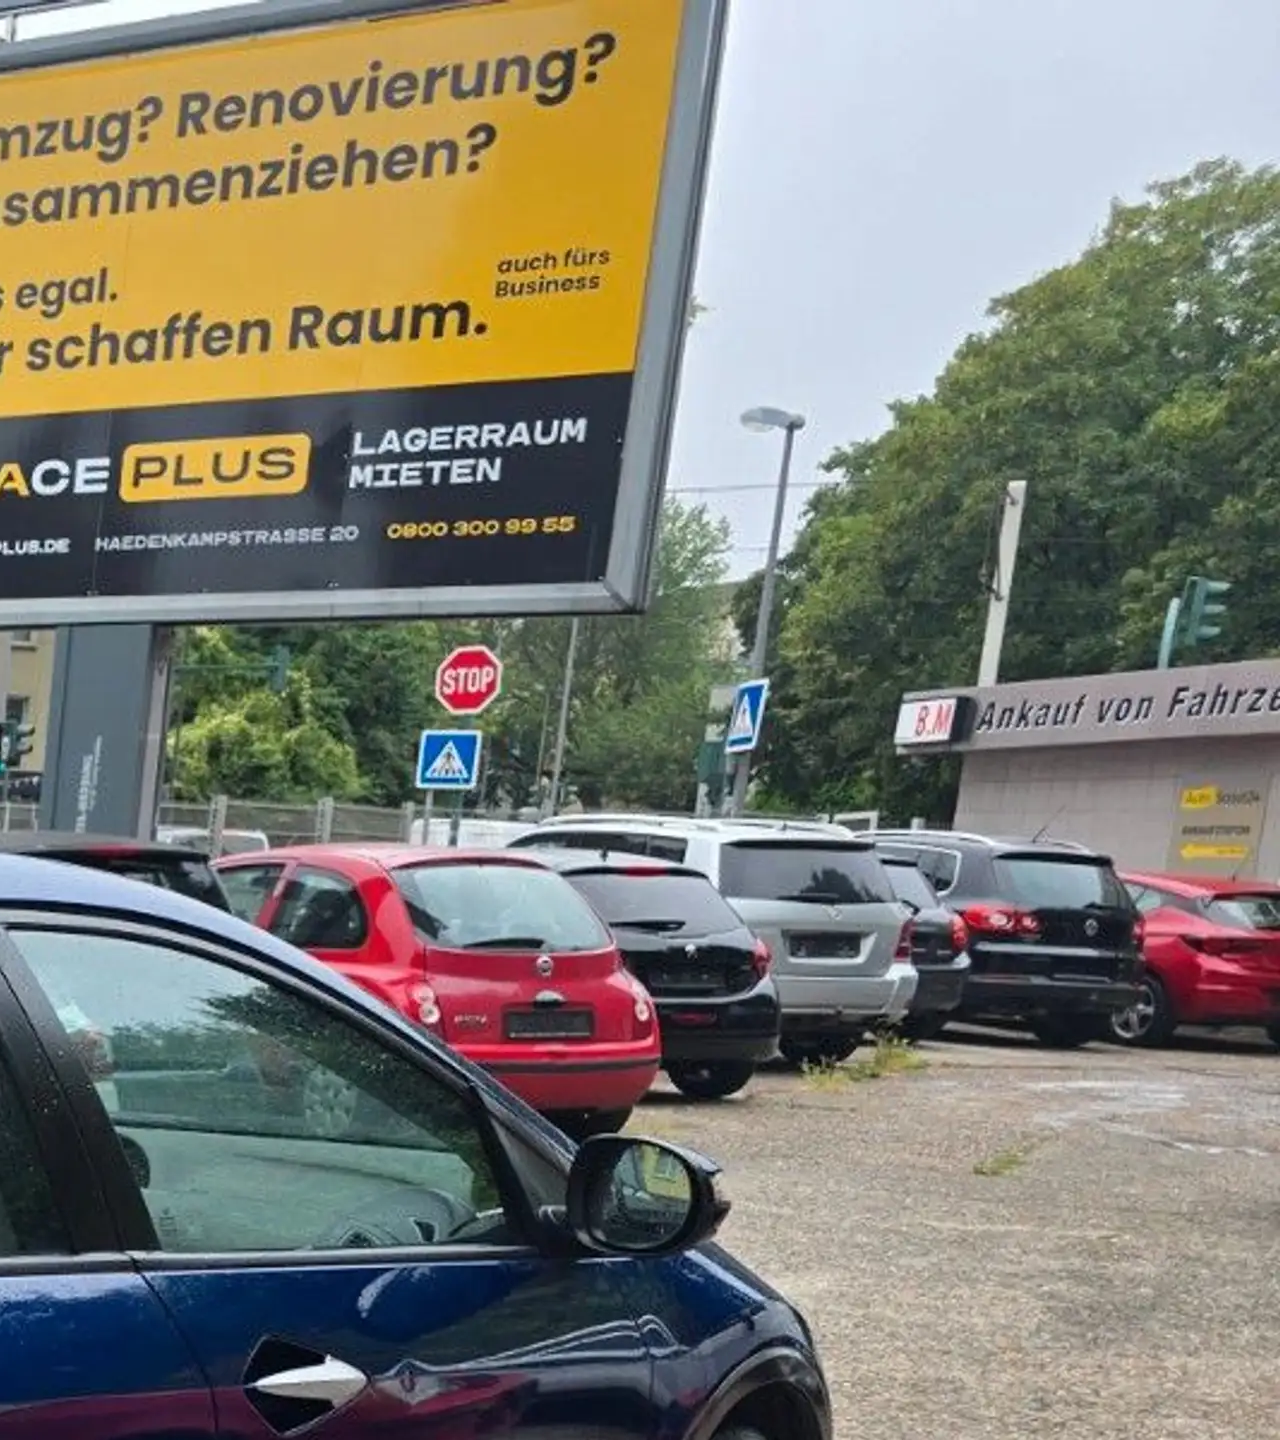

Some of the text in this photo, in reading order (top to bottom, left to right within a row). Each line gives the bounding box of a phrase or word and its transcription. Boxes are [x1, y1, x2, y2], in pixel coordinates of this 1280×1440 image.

[176, 32, 616, 138] Renovierung?
[497, 247, 610, 274] auch fürs
[15, 267, 118, 318] egal.
[495, 274, 600, 298] Business
[25, 310, 271, 371] schaffen
[289, 300, 487, 350] Raum.
[352, 417, 587, 456] LAGERRAUM
[132, 447, 297, 488] PLUS
[348, 457, 502, 488] MIETEN
[328, 525, 359, 542] 20
[386, 515, 576, 539] 0800 300 99 55
[443, 666, 494, 695] STOP
[977, 693, 1086, 732] Ankauf
[1097, 695, 1152, 725] von
